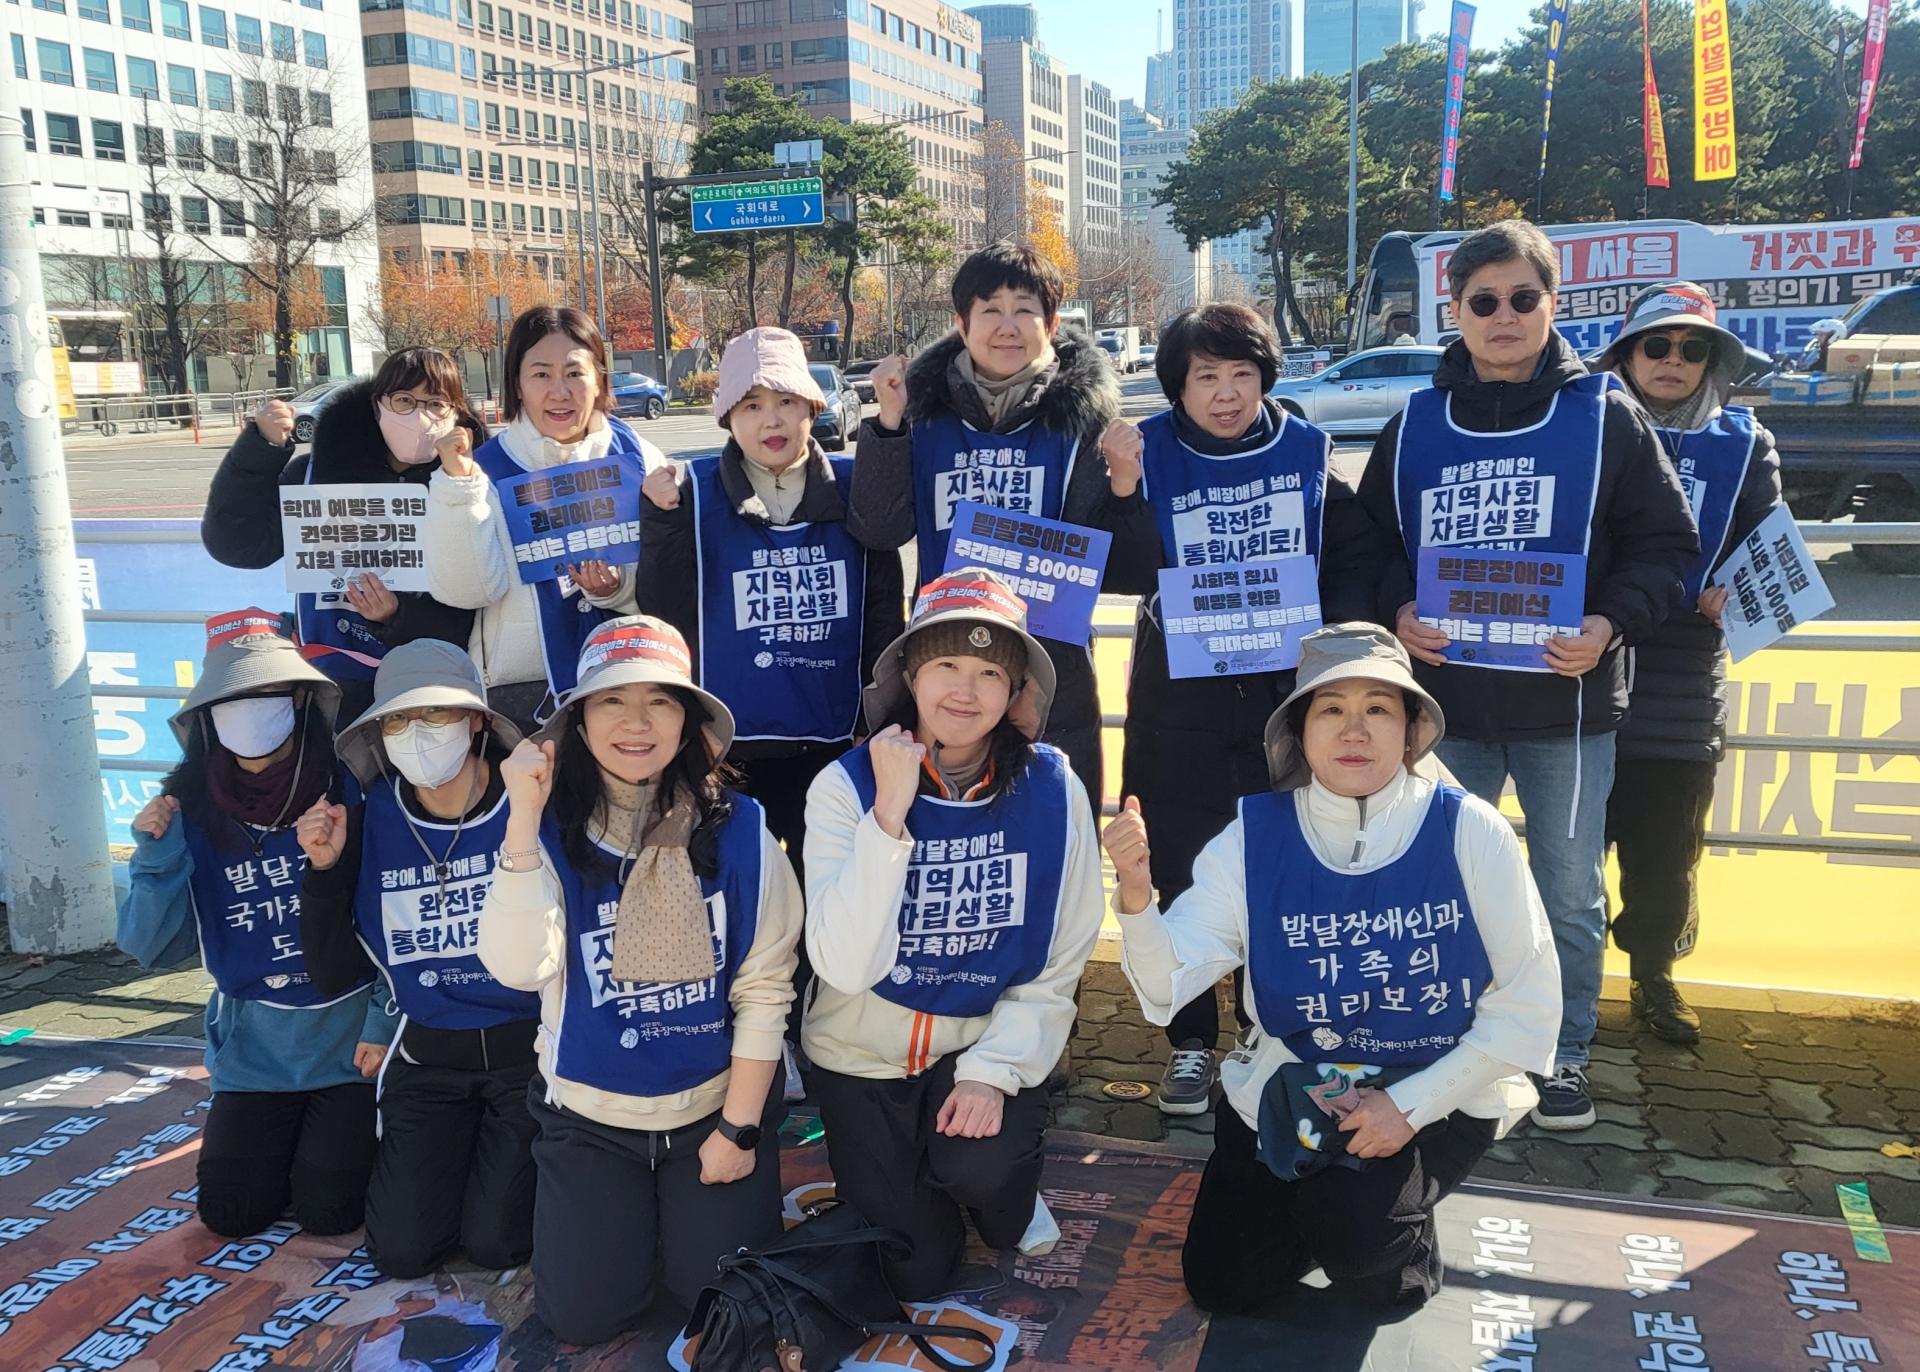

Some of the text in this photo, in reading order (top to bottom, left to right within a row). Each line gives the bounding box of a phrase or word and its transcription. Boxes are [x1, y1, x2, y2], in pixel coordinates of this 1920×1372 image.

[744, 184, 776, 196] 여의도역
[730, 214, 786, 226] Gukhoe-daero
[735, 200, 779, 216] 국회대로
[1586, 235, 1673, 279] 싸움
[1742, 227, 1877, 271] 거짓과
[1556, 285, 1639, 319] 림하
[1748, 276, 1841, 306] 정의가
[955, 448, 1027, 468] 발달장애인
[1440, 456, 1536, 485] 발달장애인
[513, 464, 623, 507] 발달장애인
[947, 468, 1032, 498] 지역사회
[1172, 472, 1301, 512] 장애, 비장애를 넘어
[1431, 479, 1541, 515] 지역사회
[282, 497, 427, 518] 학대 예방을 위한
[529, 496, 616, 534] 권리예산
[1206, 502, 1273, 535] 완전한
[300, 524, 417, 544] 권익옹호기관
[971, 511, 1091, 560] 발달장애인
[1430, 507, 1541, 543] 자립생활
[295, 549, 424, 570] 지원 확대하라!
[514, 537, 566, 563] 국회는
[752, 544, 827, 567] 발달장애인
[954, 538, 1099, 587] 주간활동 3000명
[1183, 527, 1302, 567] 통합사회로!
[746, 565, 835, 597] 지역사회
[1191, 567, 1279, 590] 사회적 참사
[1438, 557, 1566, 587] 발달장애인
[747, 592, 838, 623] 자립생활
[1193, 589, 1282, 612] 예방을 위한
[1449, 590, 1552, 617] 권리예산
[759, 622, 832, 646] 구축하라!
[1165, 612, 1249, 635] 발달장애인
[1207, 632, 1283, 654] 확대하라!
[775, 655, 836, 669] 전국장애인부모연대
[909, 830, 1005, 863] 발달장애인
[224, 855, 310, 894] 발달
[381, 866, 421, 889] 장애,
[904, 858, 1013, 900] 지역사회
[418, 880, 494, 922] 완전한
[902, 891, 1014, 934] 자립생활
[1281, 898, 1465, 948] 발달장애인과
[900, 930, 1001, 958] 구축하라!
[913, 971, 997, 988] 전국장애인부모연대
[617, 978, 717, 1019] 구축하라!
[640, 1018, 726, 1042] 전국장애인부모연대
[1346, 1035, 1455, 1053] 전국장애인부모연대
[1471, 1215, 1536, 1279] 하나.
[1618, 1233, 1692, 1300] 하나.
[0, 1257, 102, 1336] 예방
[1776, 1249, 1862, 1321] 하나.
[45, 1273, 230, 1372] 주간활
